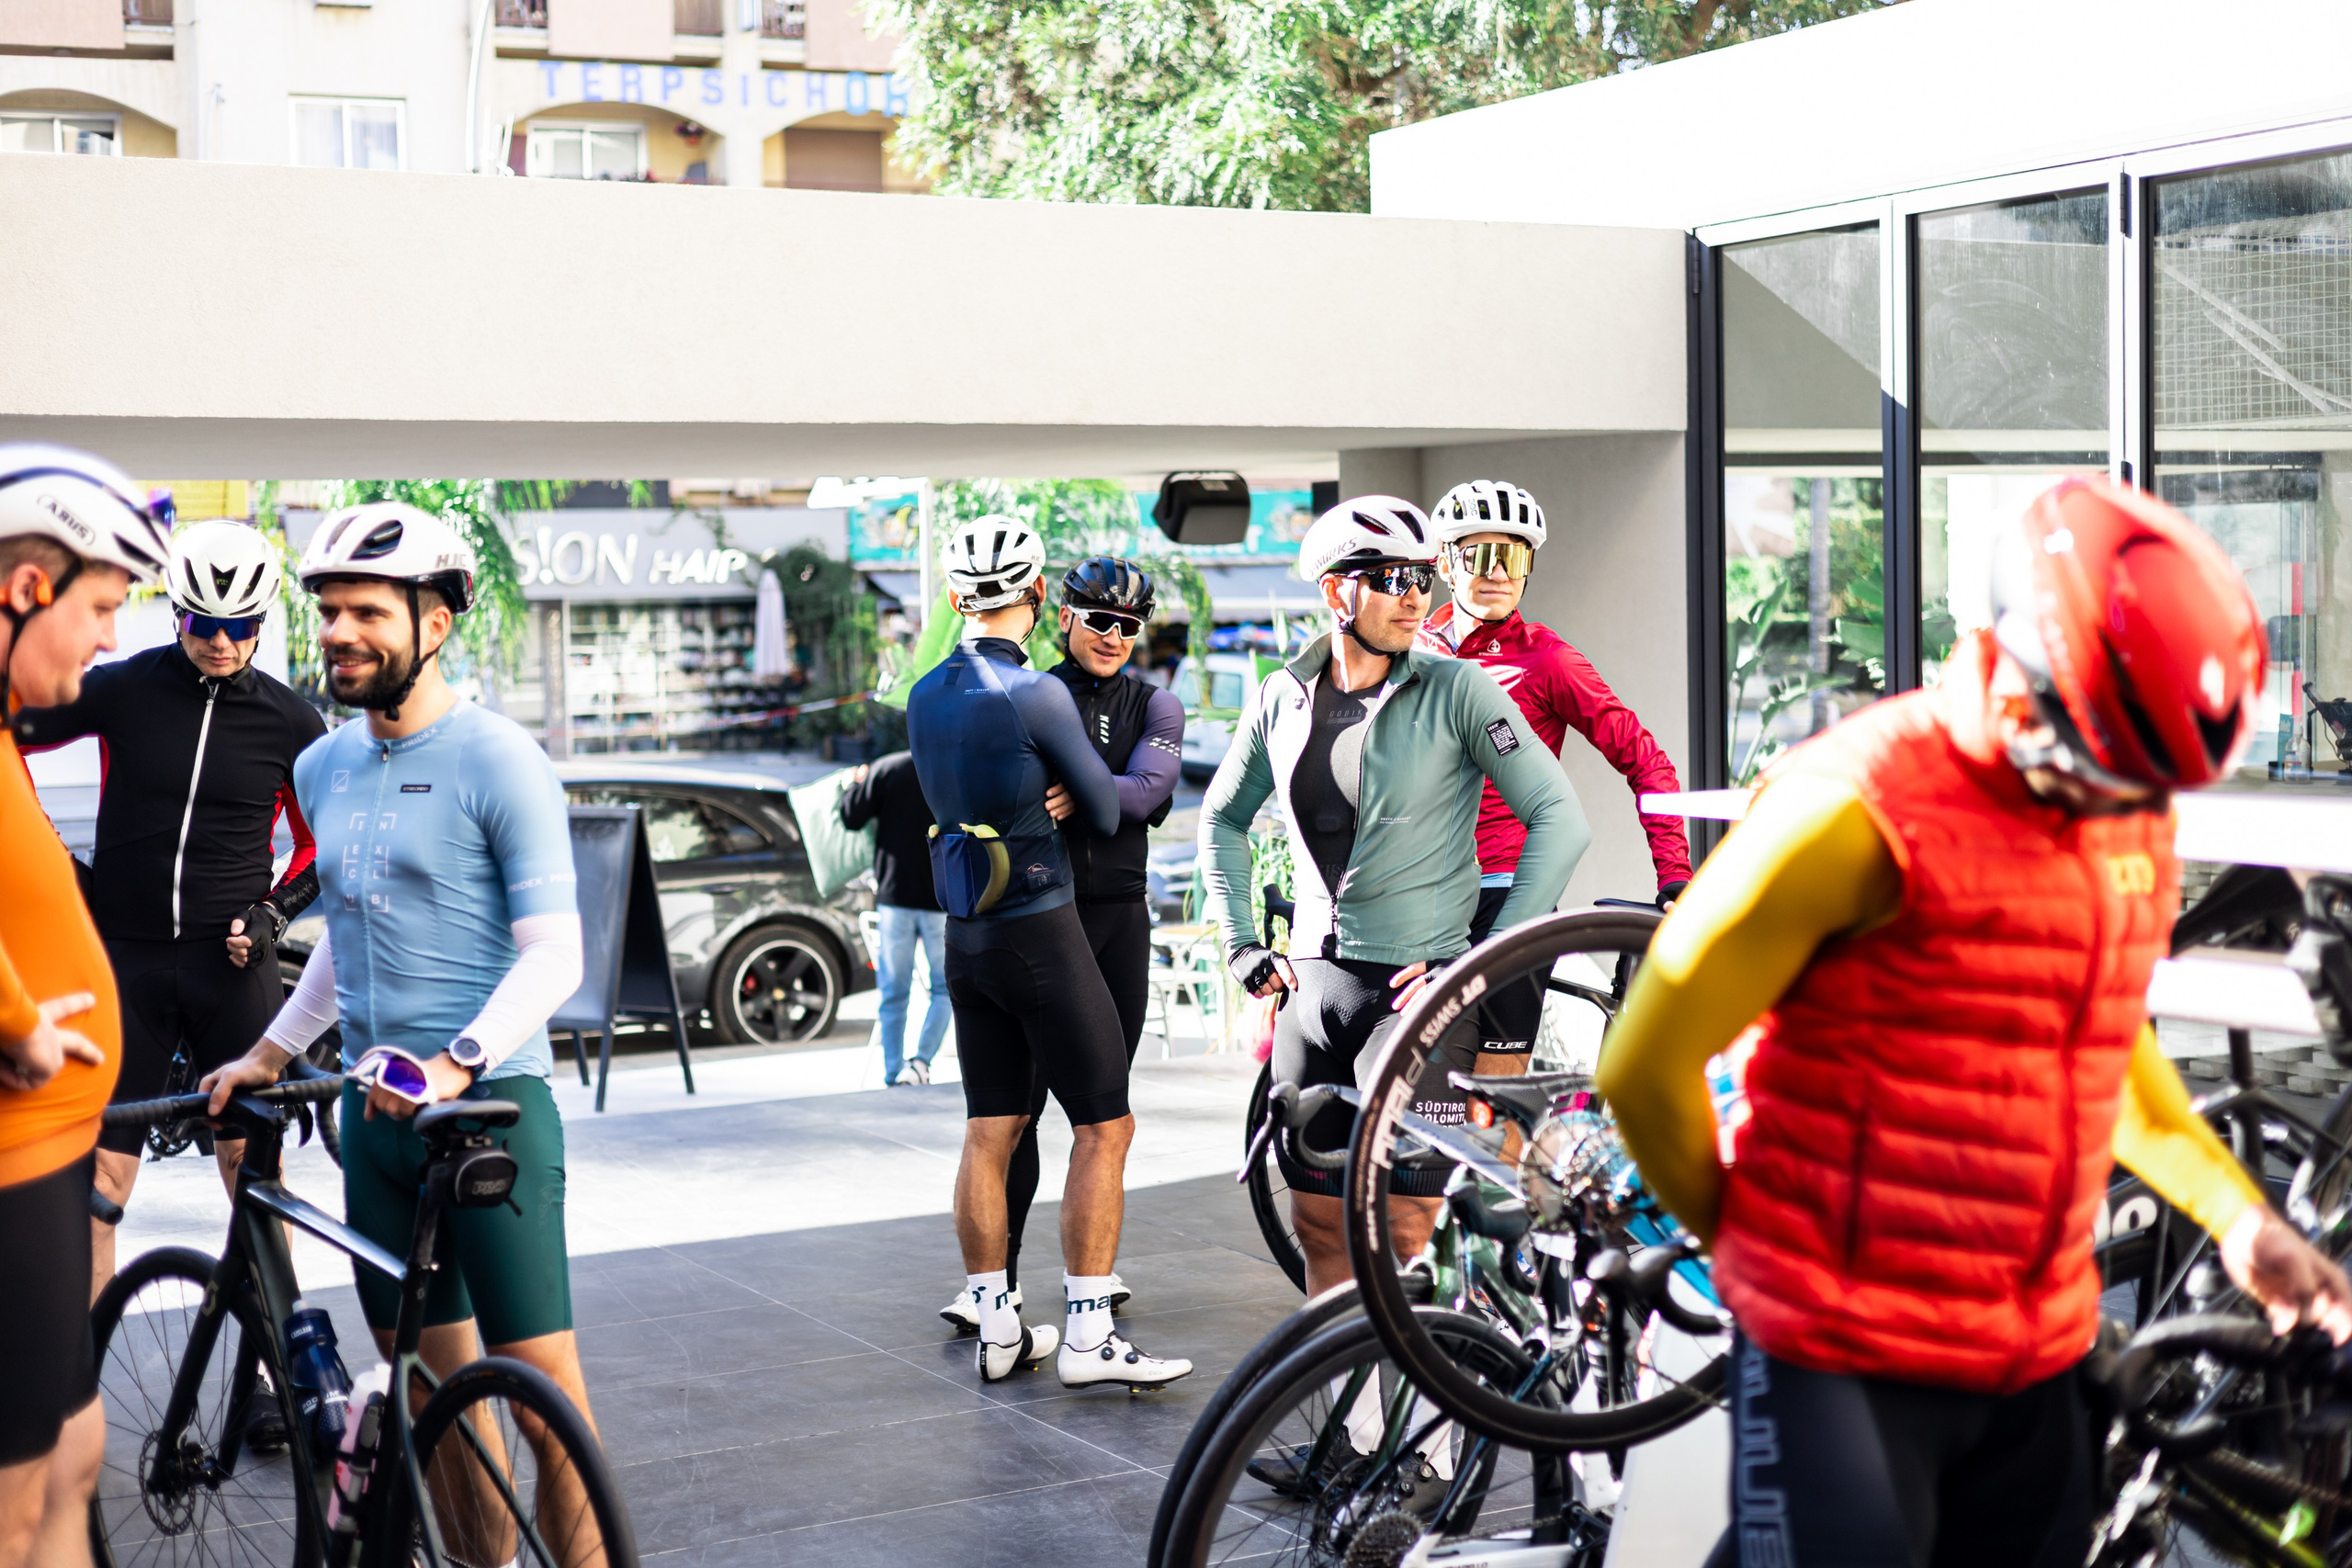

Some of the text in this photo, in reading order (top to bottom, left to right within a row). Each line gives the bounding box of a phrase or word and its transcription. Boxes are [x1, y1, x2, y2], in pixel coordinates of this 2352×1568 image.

[435, 553, 467, 569] HJC
[1329, 708, 1363, 717] GOBIK
[401, 726, 439, 749] PRIDEX
[1419, 996, 1463, 1049] SWISS
[1484, 1041, 1528, 1050] CUBE
